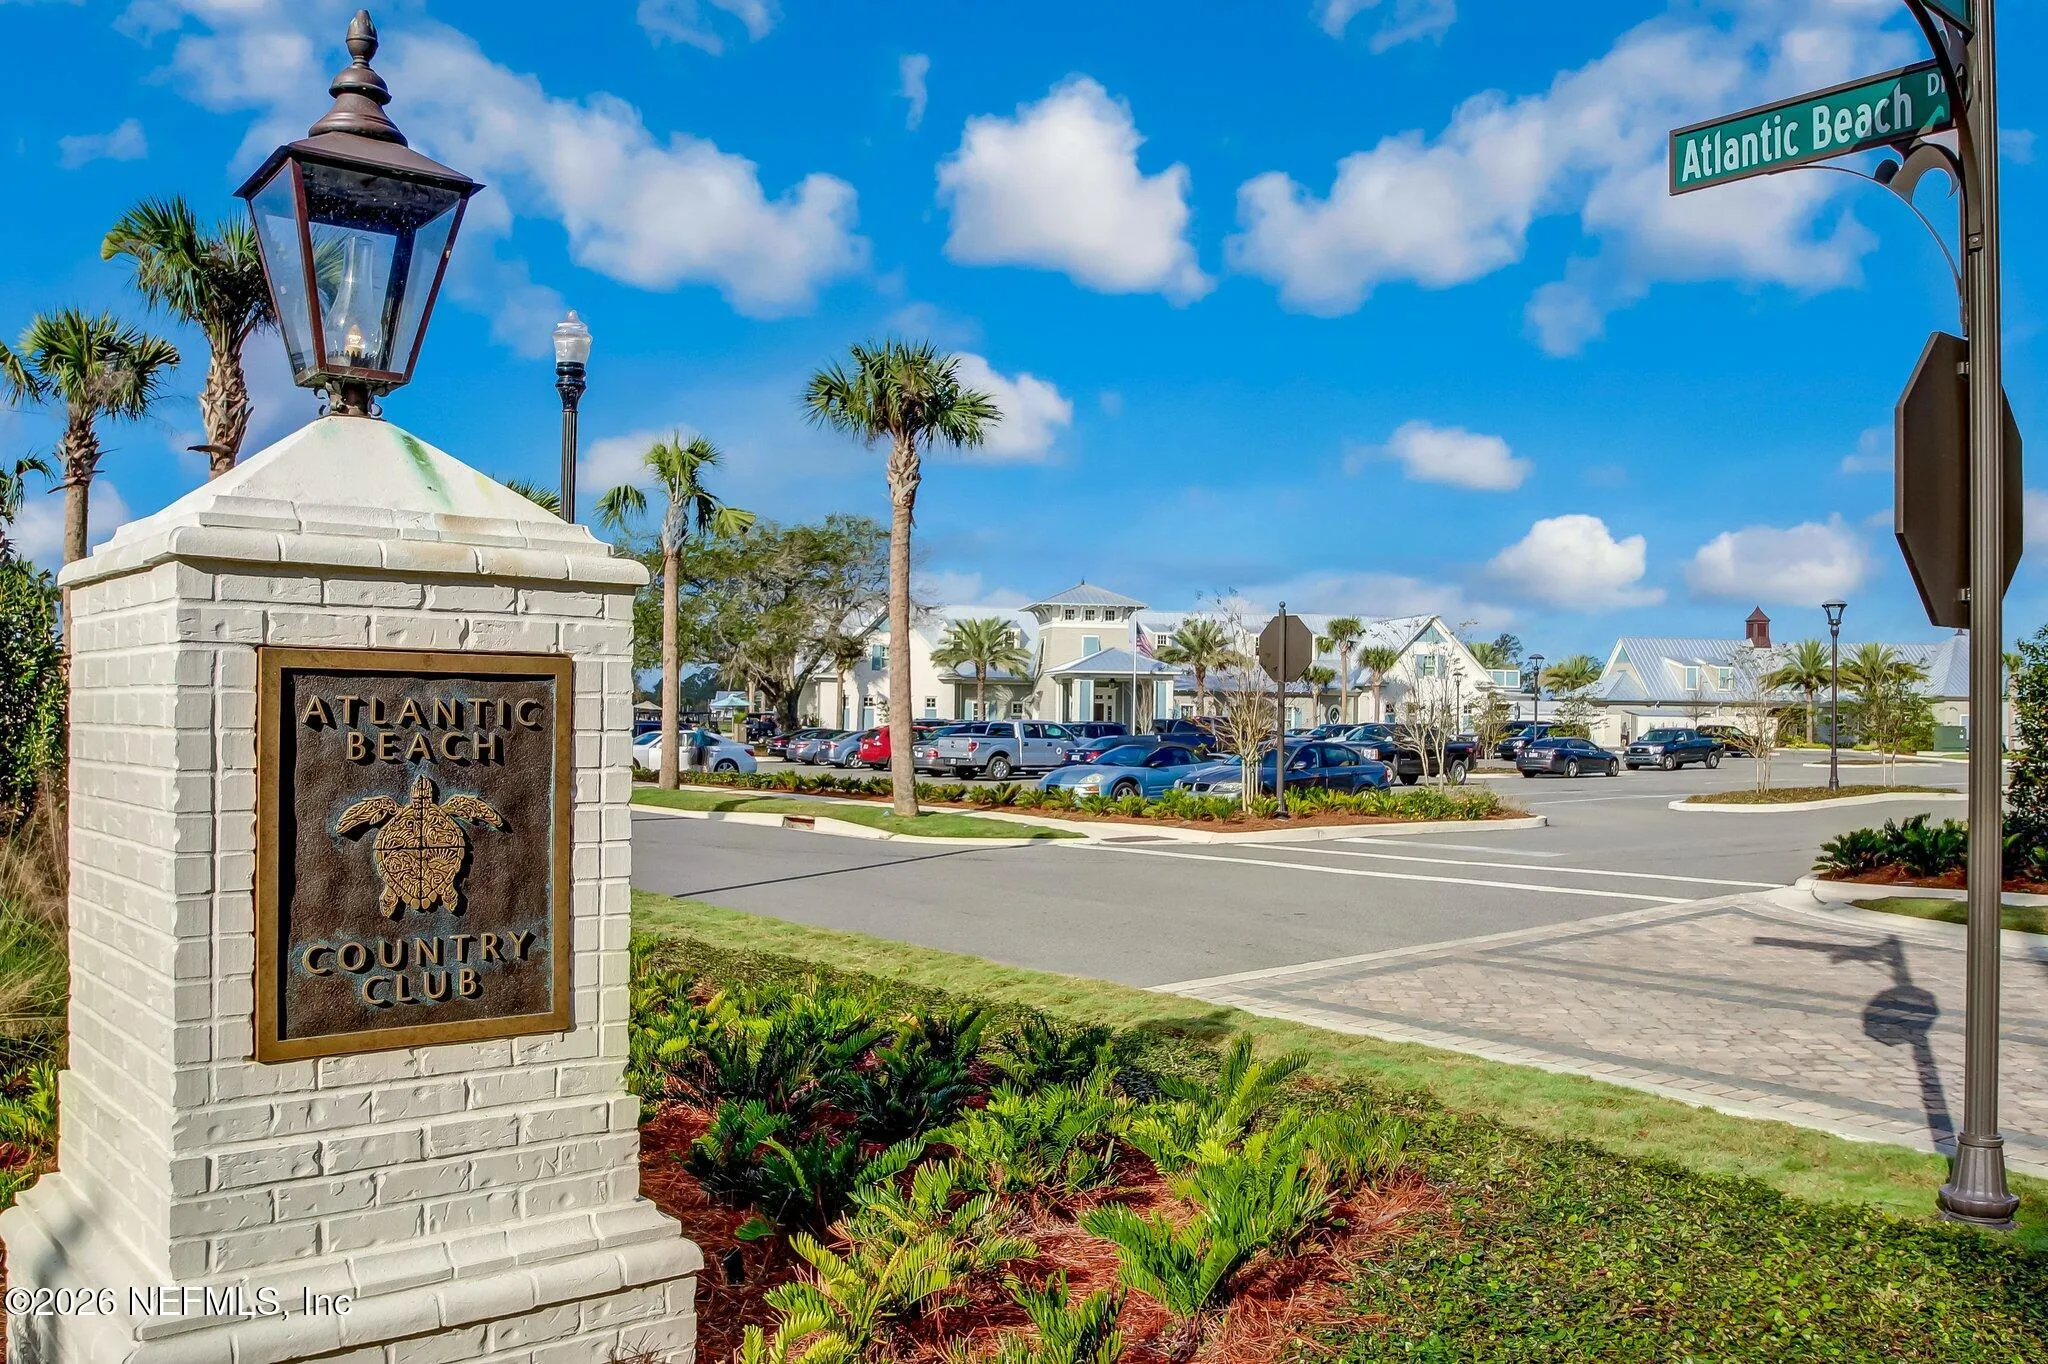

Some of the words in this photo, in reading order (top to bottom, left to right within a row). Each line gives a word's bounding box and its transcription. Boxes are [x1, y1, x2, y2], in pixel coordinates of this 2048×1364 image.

[1682, 115, 1799, 182] Atlantic
[1813, 83, 1912, 150] Beach
[301, 695, 540, 726] ATLANTIC
[346, 731, 496, 761] BEACH
[302, 930, 531, 974] COUNTRY
[361, 967, 477, 1005] CLUB
